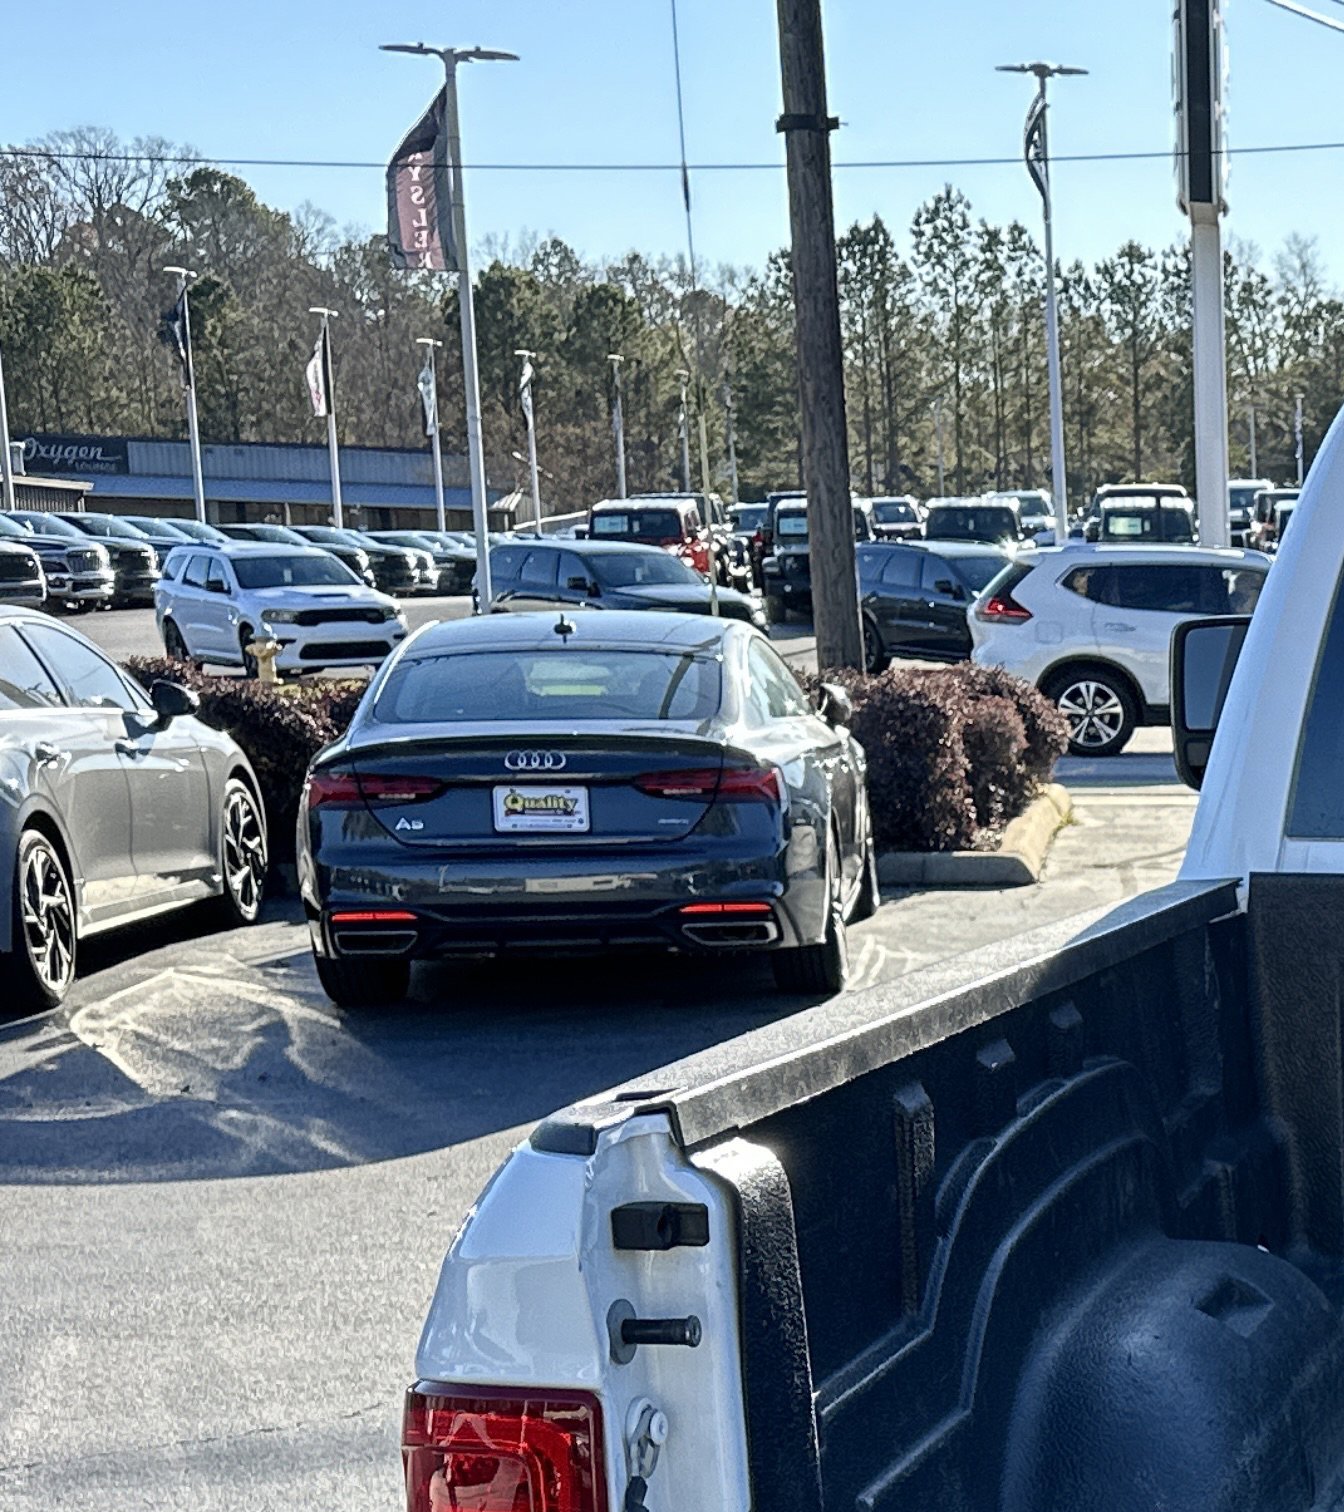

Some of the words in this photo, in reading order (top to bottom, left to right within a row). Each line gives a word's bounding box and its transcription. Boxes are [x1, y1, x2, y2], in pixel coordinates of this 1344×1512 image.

[24, 437, 120, 465] Oxygen
[503, 793, 579, 812] Quality
[395, 817, 424, 830] A5
